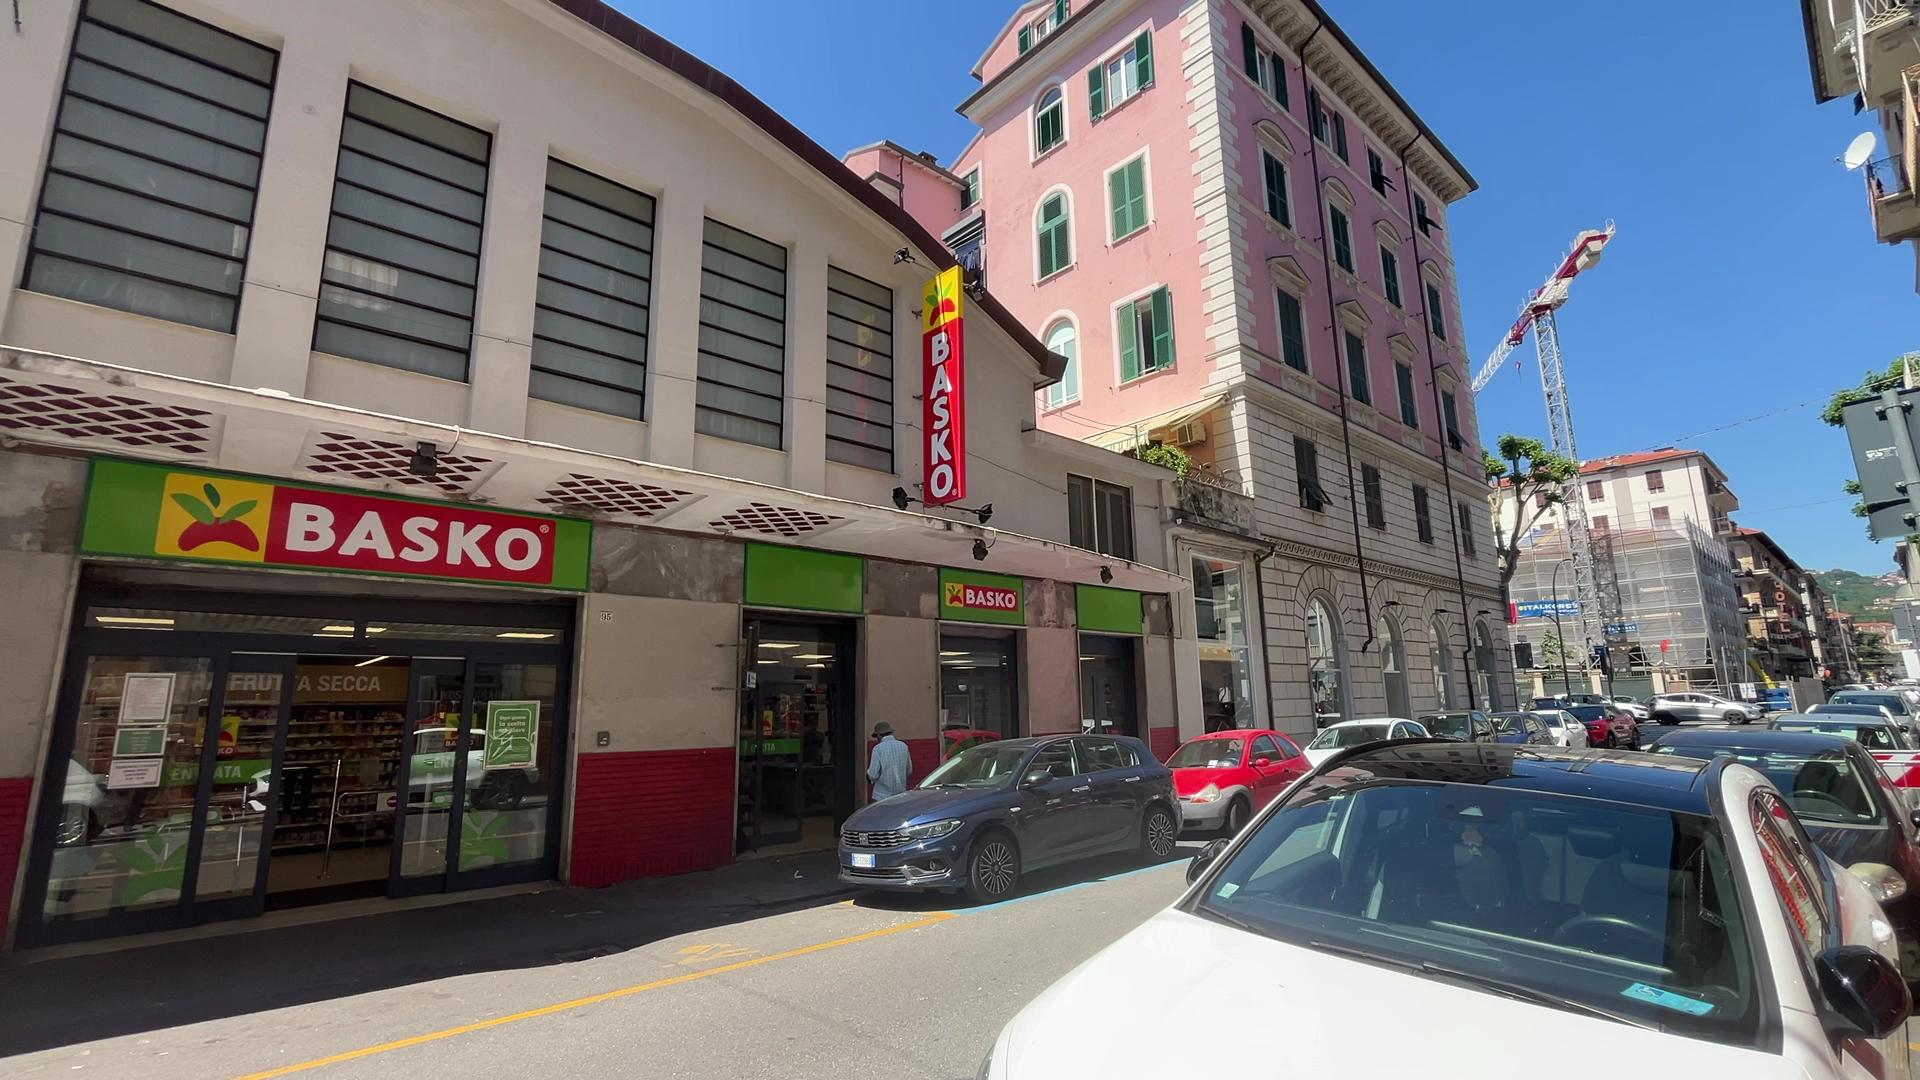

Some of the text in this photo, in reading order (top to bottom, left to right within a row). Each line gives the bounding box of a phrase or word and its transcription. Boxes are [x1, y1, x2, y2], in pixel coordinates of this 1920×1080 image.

[929, 331, 954, 498] BASKO
[285, 502, 542, 571] BASKO
[965, 588, 1016, 609] BASKO
[229, 674, 312, 692] FRUTA
[317, 675, 381, 693] SECCA
[171, 765, 241, 781] ENATA
